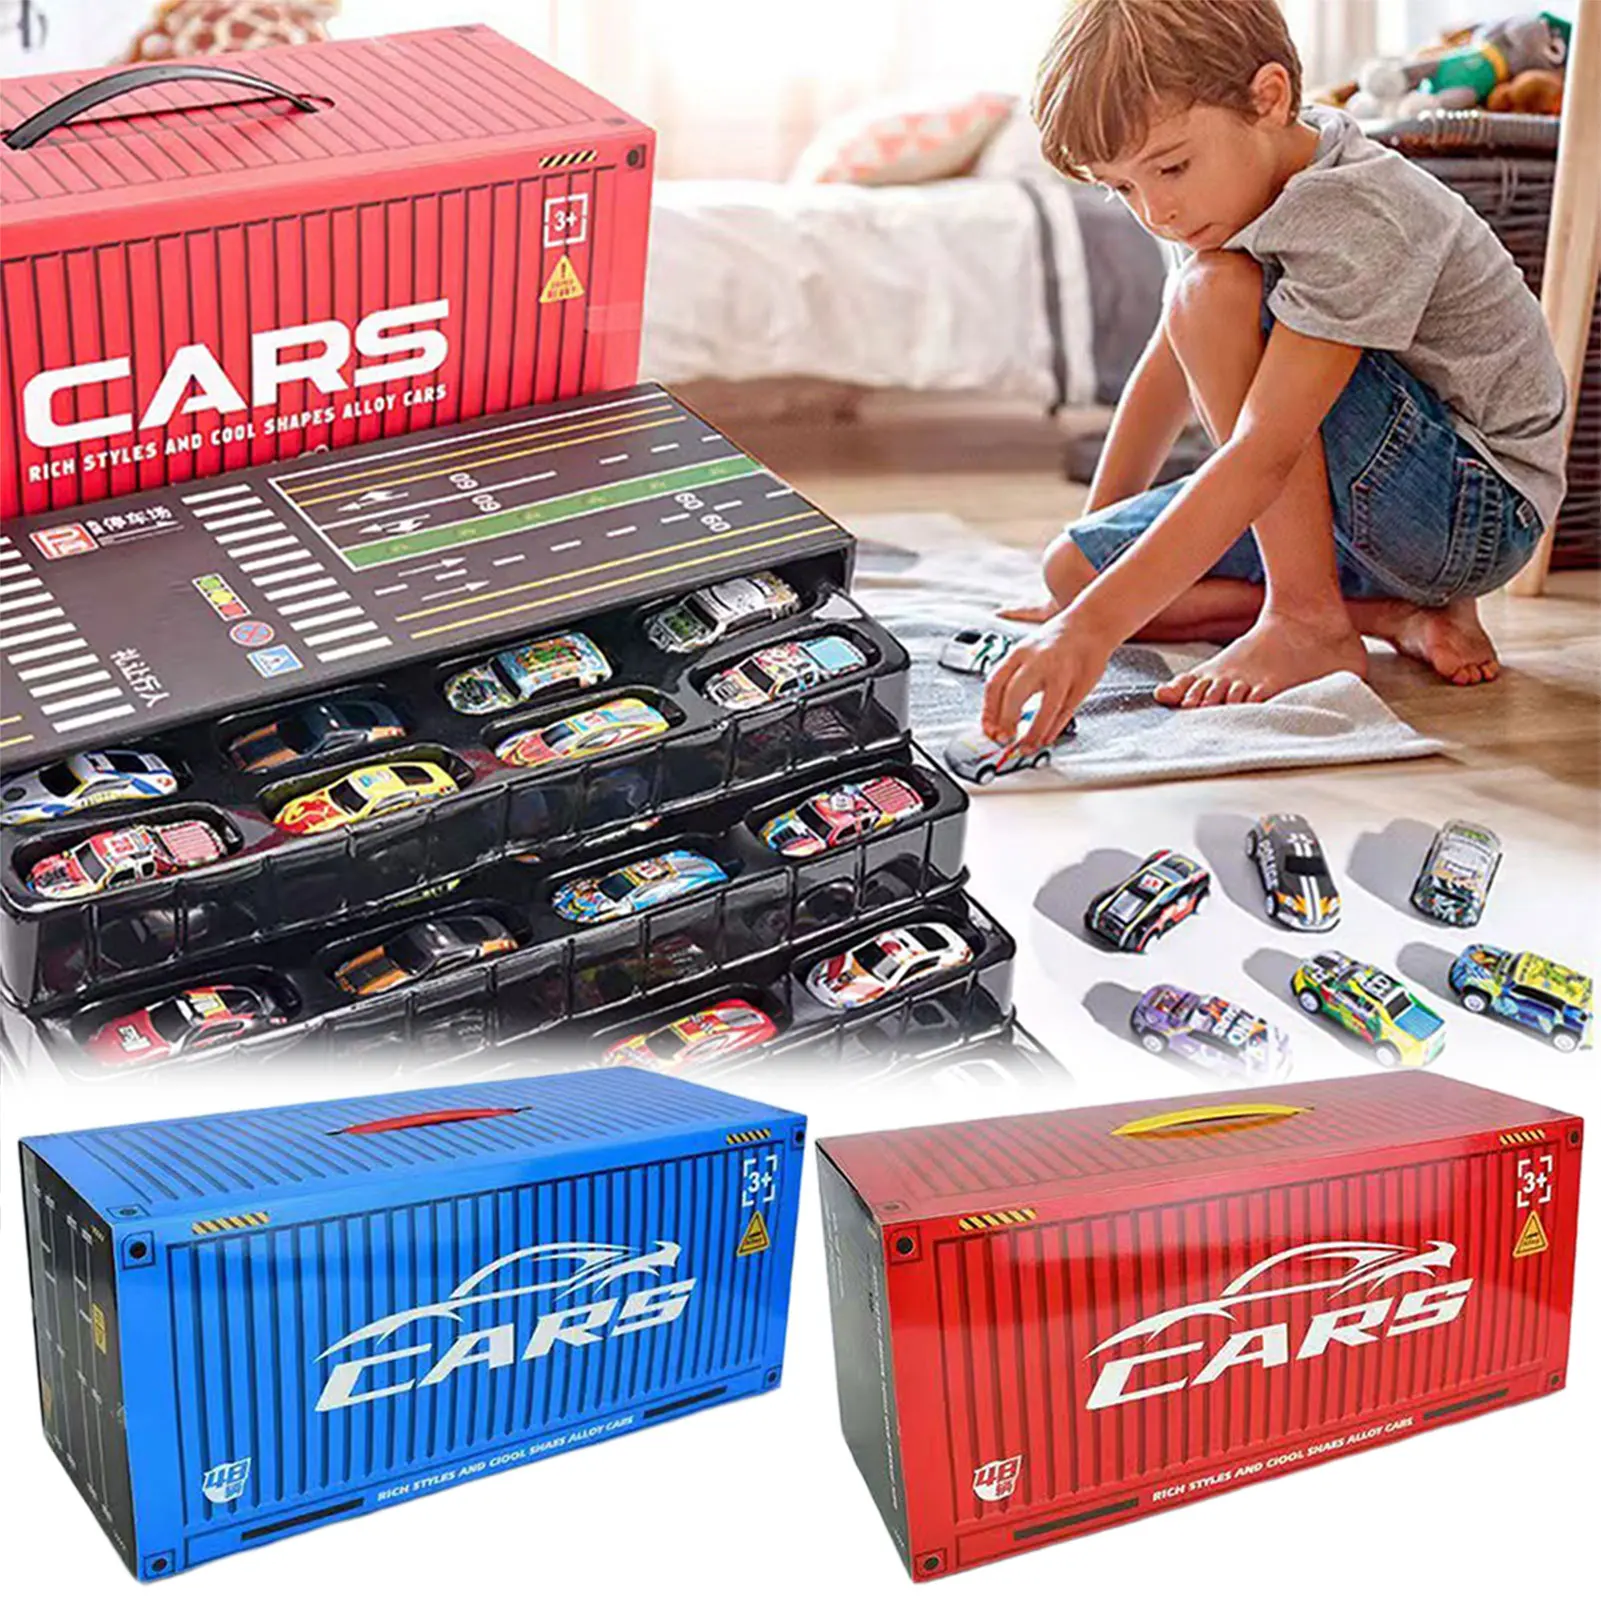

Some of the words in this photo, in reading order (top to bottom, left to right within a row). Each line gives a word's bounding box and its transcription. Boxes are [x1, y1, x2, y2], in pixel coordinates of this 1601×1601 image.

[554, 210, 577, 231] 3+
[22, 298, 449, 447] CARS
[28, 458, 76, 482] RICH
[83, 442, 158, 472] STYLES
[164, 433, 203, 455] AND
[210, 423, 256, 446] COOL
[263, 406, 336, 435] SHAPES
[342, 394, 397, 420] ALLOY
[403, 383, 447, 406] CARS
[449, 472, 478, 490] 60
[471, 494, 501, 512] 60
[674, 492, 705, 511] 60
[701, 514, 732, 533] 60
[748, 1171, 773, 1193] 3+
[1523, 1171, 1548, 1194] 3+
[314, 1277, 697, 1413] CARS
[1085, 1278, 1474, 1411] CARS
[377, 1484, 410, 1501] RICH
[412, 1469, 457, 1491] STYLES
[457, 1460, 487, 1477] AND
[567, 1422, 607, 1444] ALLOY
[605, 1415, 635, 1431] CARS
[976, 1458, 1019, 1486] 48
[1152, 1484, 1186, 1502] RICH
[1187, 1470, 1232, 1491] STYLES
[1233, 1462, 1264, 1479] AND
[1345, 1425, 1385, 1445] ALLOY
[1384, 1416, 1415, 1433] CARS
[206, 1460, 248, 1489] 48
